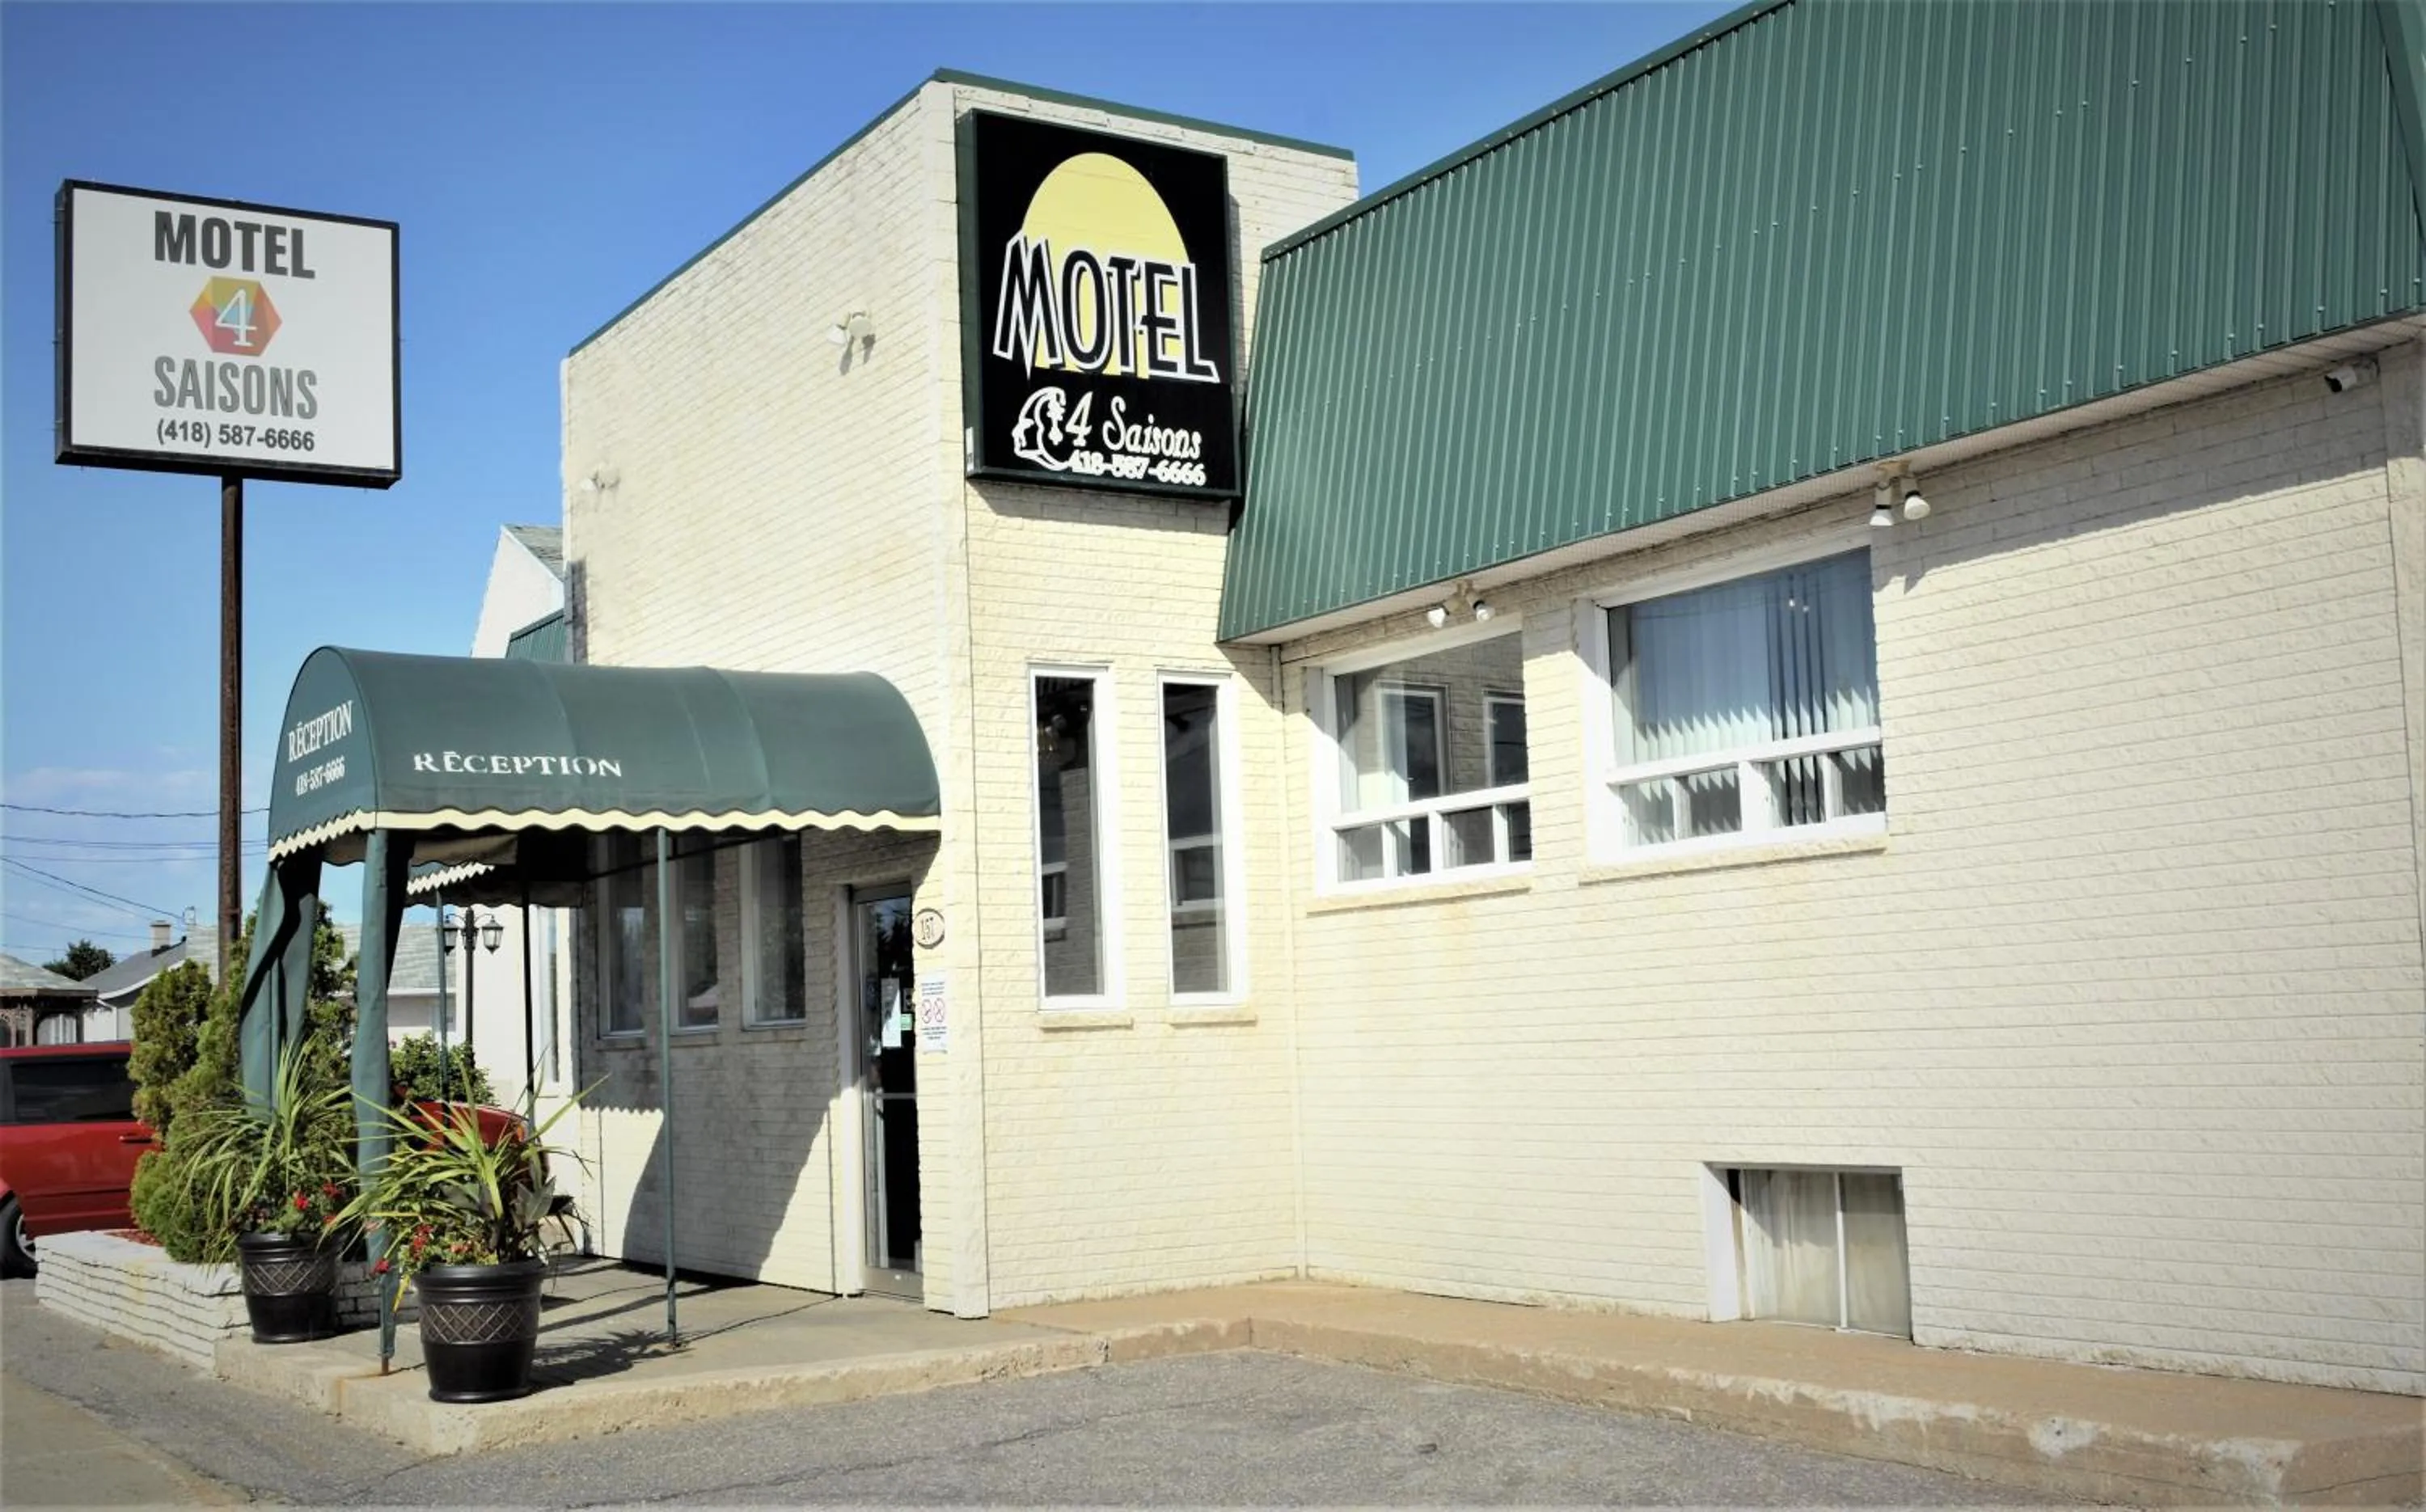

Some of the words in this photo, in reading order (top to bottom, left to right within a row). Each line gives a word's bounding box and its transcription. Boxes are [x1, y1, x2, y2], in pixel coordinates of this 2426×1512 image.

[154, 210, 316, 279] MOTEL
[214, 288, 257, 347] 4
[993, 229, 1220, 383] MOTEL
[154, 355, 318, 420] SAISONS
[157, 418, 211, 448] (418)
[218, 424, 315, 451] 587-6666
[1065, 391, 1093, 446] 4
[1102, 395, 1202, 459] Saisons
[1068, 449, 1207, 486] 418-587-6666
[288, 699, 353, 762] RÉCEPTION
[413, 751, 622, 777] RÉCEPTION
